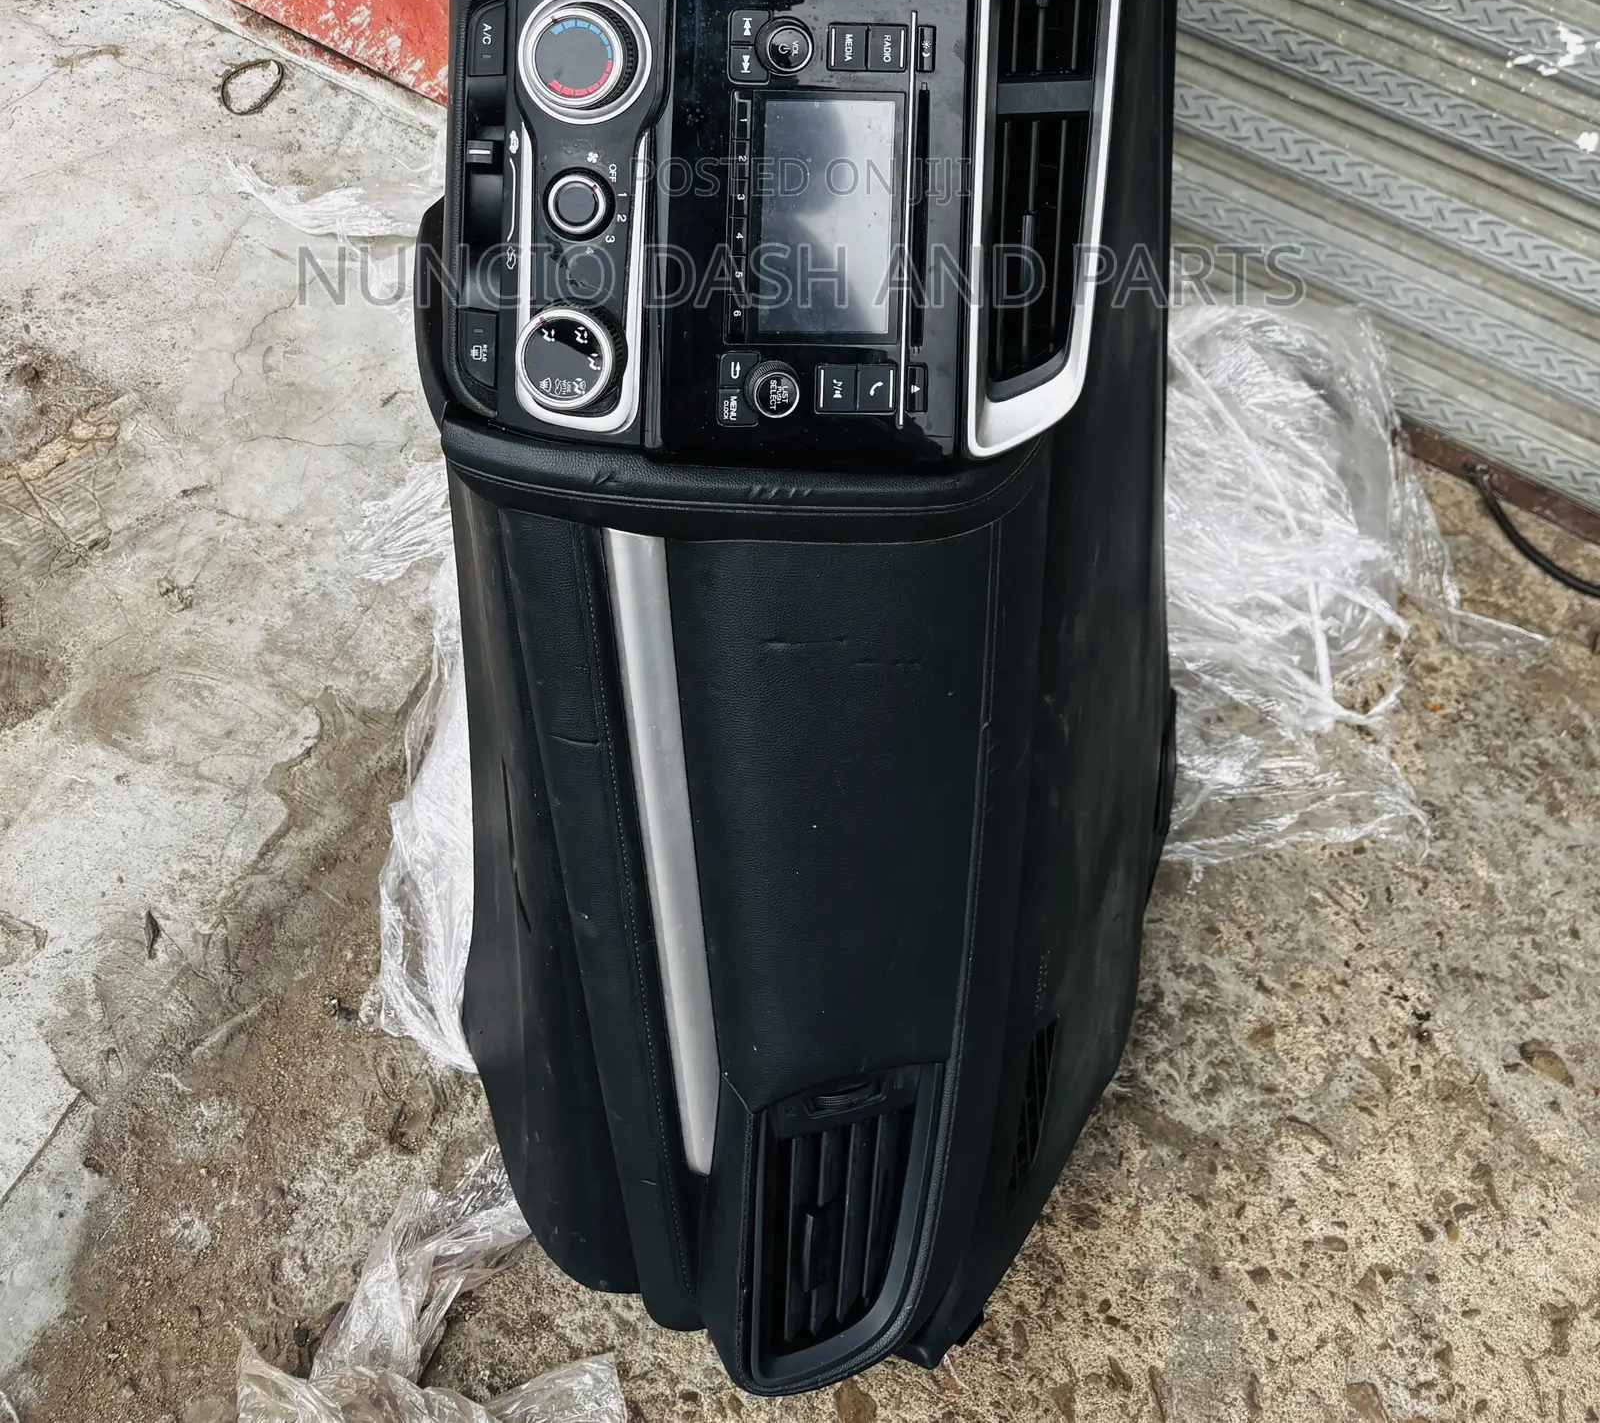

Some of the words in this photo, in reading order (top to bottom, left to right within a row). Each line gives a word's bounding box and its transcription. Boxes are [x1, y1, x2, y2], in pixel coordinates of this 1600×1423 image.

[482, 23, 492, 46] A/C
[844, 34, 852, 62] MEDIA
[883, 34, 891, 63] RADIO
[608, 163, 617, 183] OFF
[616, 214, 628, 223] 2
[605, 234, 616, 243] 3
[736, 232, 744, 240] 4
[585, 246, 596, 255] 4
[730, 396, 738, 421] MENU
